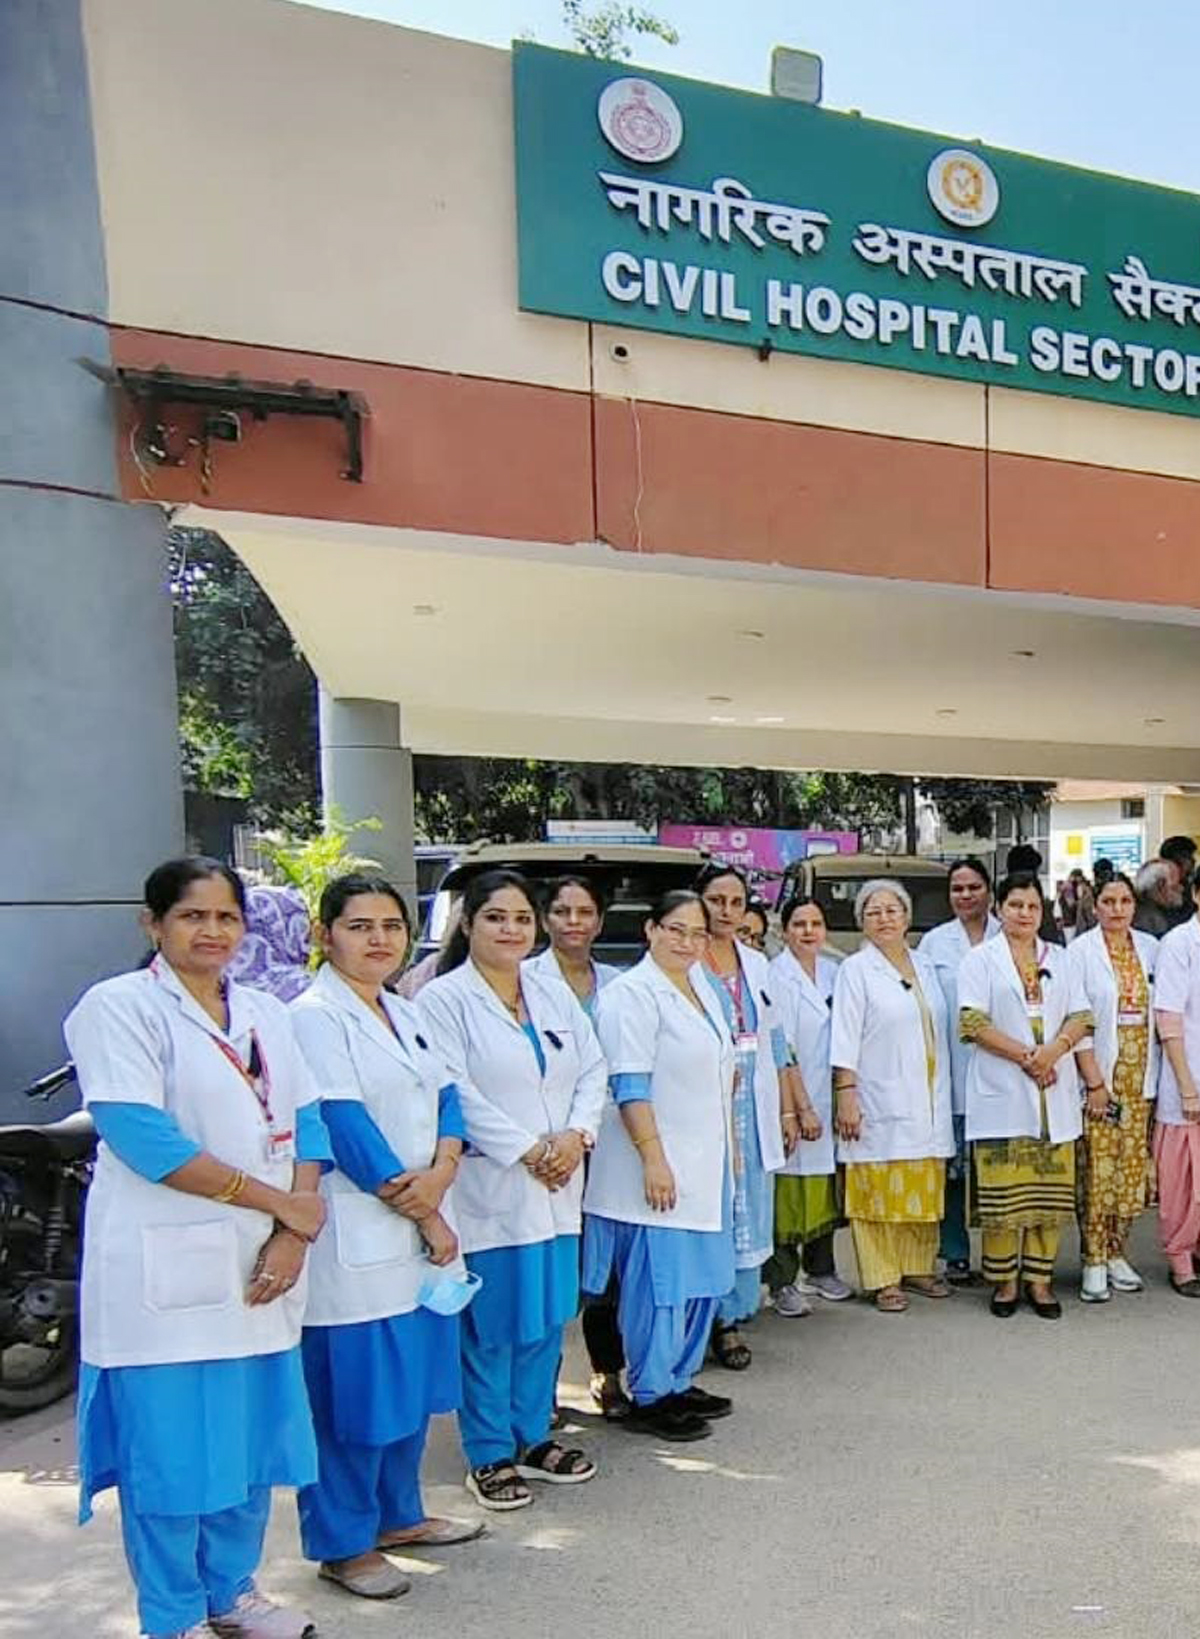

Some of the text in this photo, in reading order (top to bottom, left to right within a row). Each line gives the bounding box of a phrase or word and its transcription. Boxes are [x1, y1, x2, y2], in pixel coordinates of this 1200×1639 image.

[597, 171, 830, 255] नागरिक
[852, 222, 1087, 309] अस्पताल
[602, 250, 751, 324] CIVIL
[766, 278, 1019, 366] HOSPITAL
